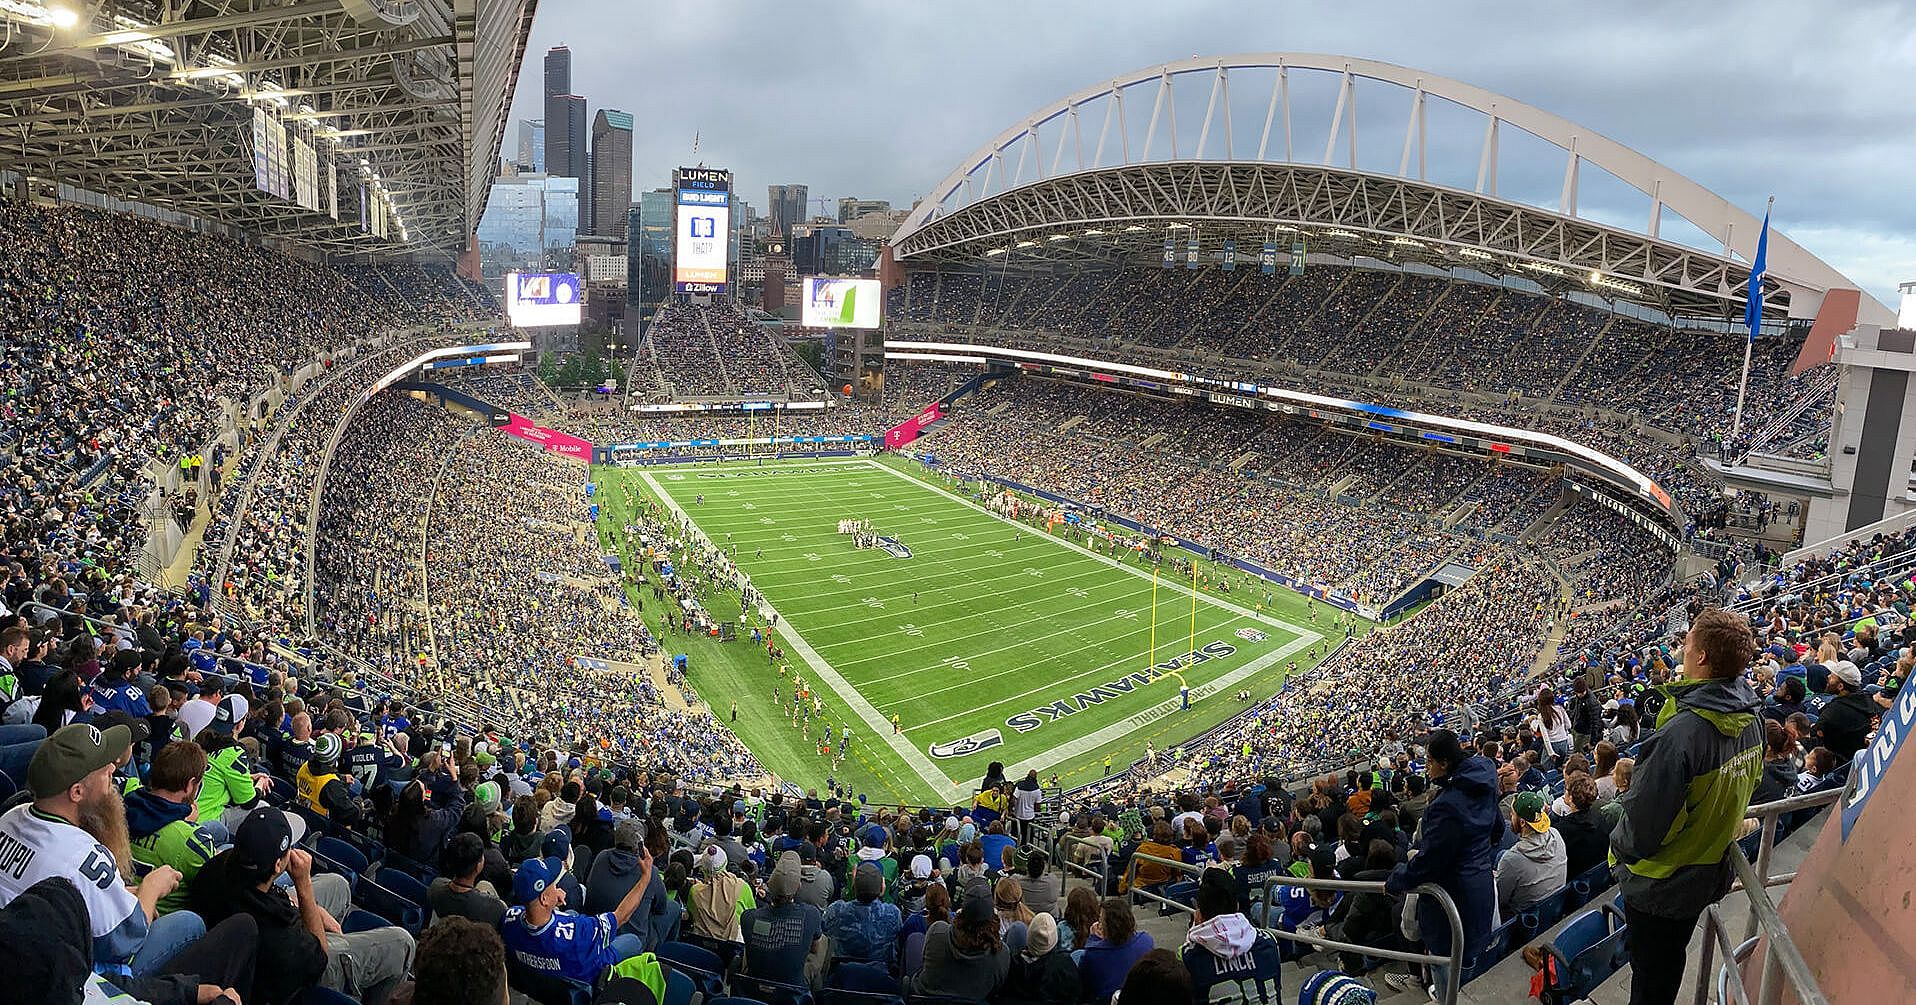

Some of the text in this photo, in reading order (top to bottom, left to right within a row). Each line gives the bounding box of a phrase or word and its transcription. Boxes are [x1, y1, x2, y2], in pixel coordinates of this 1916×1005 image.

[680, 170, 728, 182] LUMEN
[692, 181, 715, 189] FIELD
[700, 193, 725, 203] LIGHT
[1163, 251, 1175, 262] 45
[1224, 251, 1234, 263] 12
[1292, 255, 1302, 267] 71
[693, 283, 718, 292] Zillow
[1211, 393, 1251, 409] LUMEN
[559, 444, 582, 453] Mobile
[1592, 491, 1628, 516] WELCOME
[1631, 511, 1641, 523] TO
[1643, 520, 1667, 542] LUMEN
[942, 655, 969, 670] 10
[1005, 640, 1237, 734] SEAHAWKS
[351, 752, 376, 763] WOOLEN
[351, 763, 378, 794] 27
[744, 805, 758, 819] 29
[1247, 868, 1277, 885] SHERMAN
[554, 920, 575, 941] 21
[514, 949, 562, 971] WITHERSPOON
[1213, 950, 1257, 976] LYNCH
